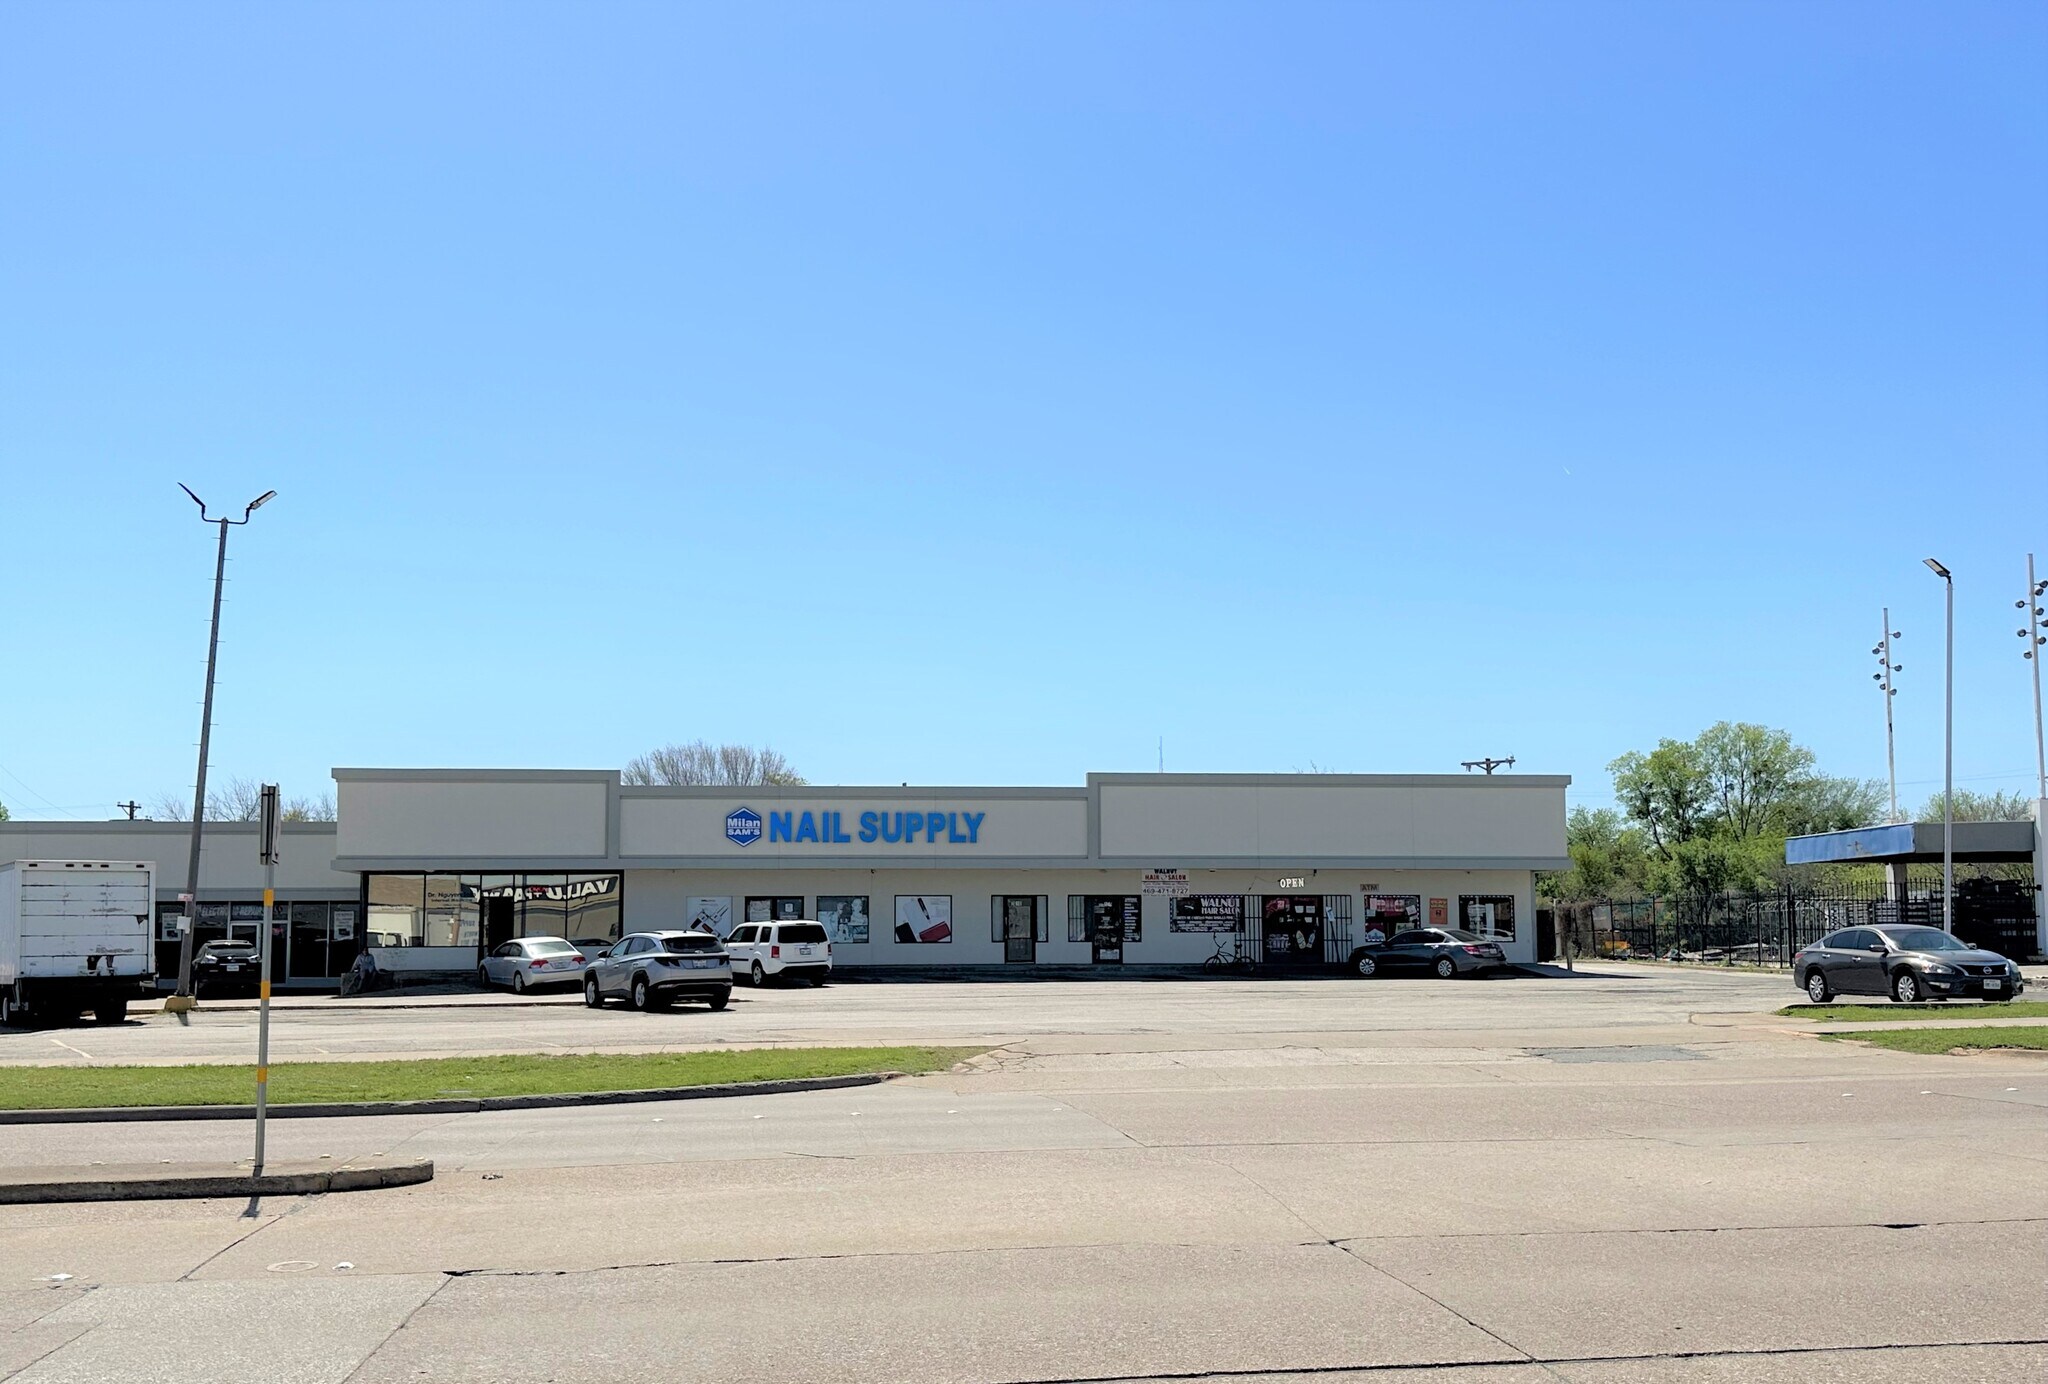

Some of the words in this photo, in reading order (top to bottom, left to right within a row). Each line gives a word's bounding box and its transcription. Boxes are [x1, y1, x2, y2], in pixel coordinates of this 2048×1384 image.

[727, 817, 761, 828] Milan
[770, 812, 850, 842] NAIL
[859, 811, 985, 843] SUPPLY
[727, 828, 761, 836] SAM'S
[1280, 878, 1304, 888] OPEN
[1200, 898, 1240, 907] WALNUT
